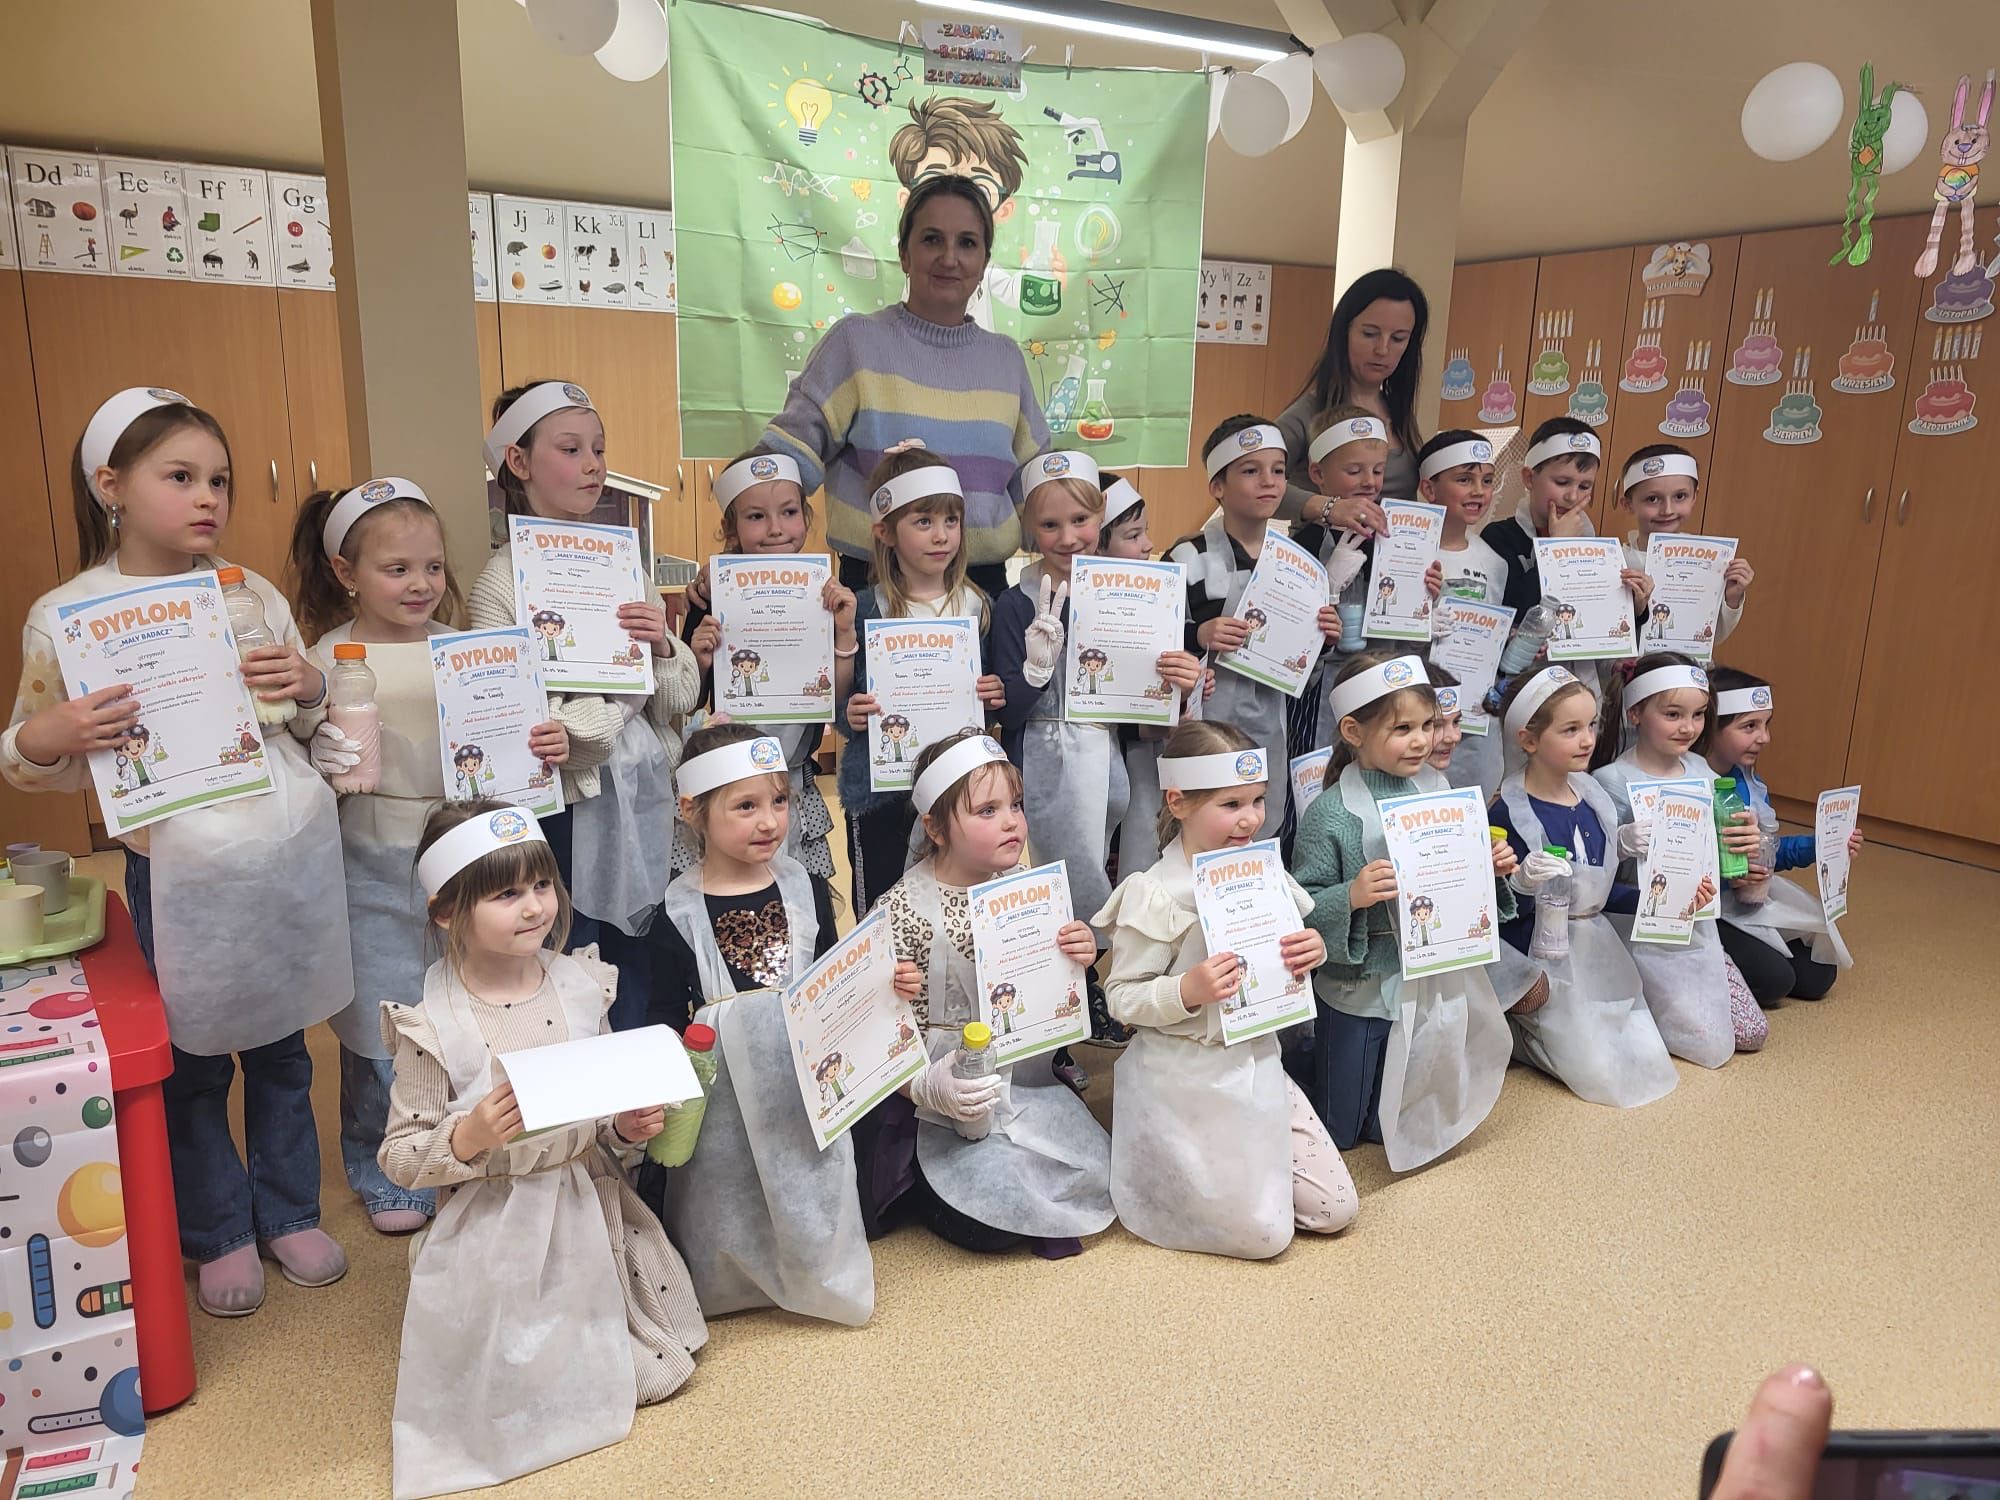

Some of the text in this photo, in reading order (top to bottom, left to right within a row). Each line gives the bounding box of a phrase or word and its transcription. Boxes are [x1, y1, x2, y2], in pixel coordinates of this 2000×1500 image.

[24, 162, 63, 186] Dd
[117, 171, 149, 193] Ee
[199, 179, 227, 200] Ff
[283, 187, 316, 213] Gg
[513, 210, 527, 233] Jj
[574, 215, 602, 235] Kk
[638, 221, 656, 239] Ll
[1201, 270, 1217, 288] Yy
[1236, 272, 1252, 287] Zz
[1938, 308, 1979, 319] LISTOPAD
[1635, 380, 1652, 389] MAJ
[1741, 371, 1767, 381] LIPIEC
[1666, 422, 1704, 433] CZERWIEC
[1392, 513, 1431, 530] DYPLOM
[535, 533, 614, 556] DYPLOM
[1552, 547, 1606, 559] DYPLOM
[1663, 546, 1719, 561] DYPLOM
[1276, 547, 1319, 581] DYPLOM
[735, 570, 809, 588] DYPLOM
[1092, 573, 1161, 592] DYPLOM
[88, 599, 193, 641] DYPLOM
[884, 632, 954, 652] DYPLOM
[450, 645, 518, 673] DYPLOM
[1666, 803, 1701, 823] DYPLOM
[1824, 799, 1851, 815] DYPLOM
[1400, 807, 1465, 831] DYPLOM
[1209, 860, 1264, 887] DYPLOM
[988, 884, 1051, 918] DYPLOM
[805, 937, 872, 1003] DYPLOM
